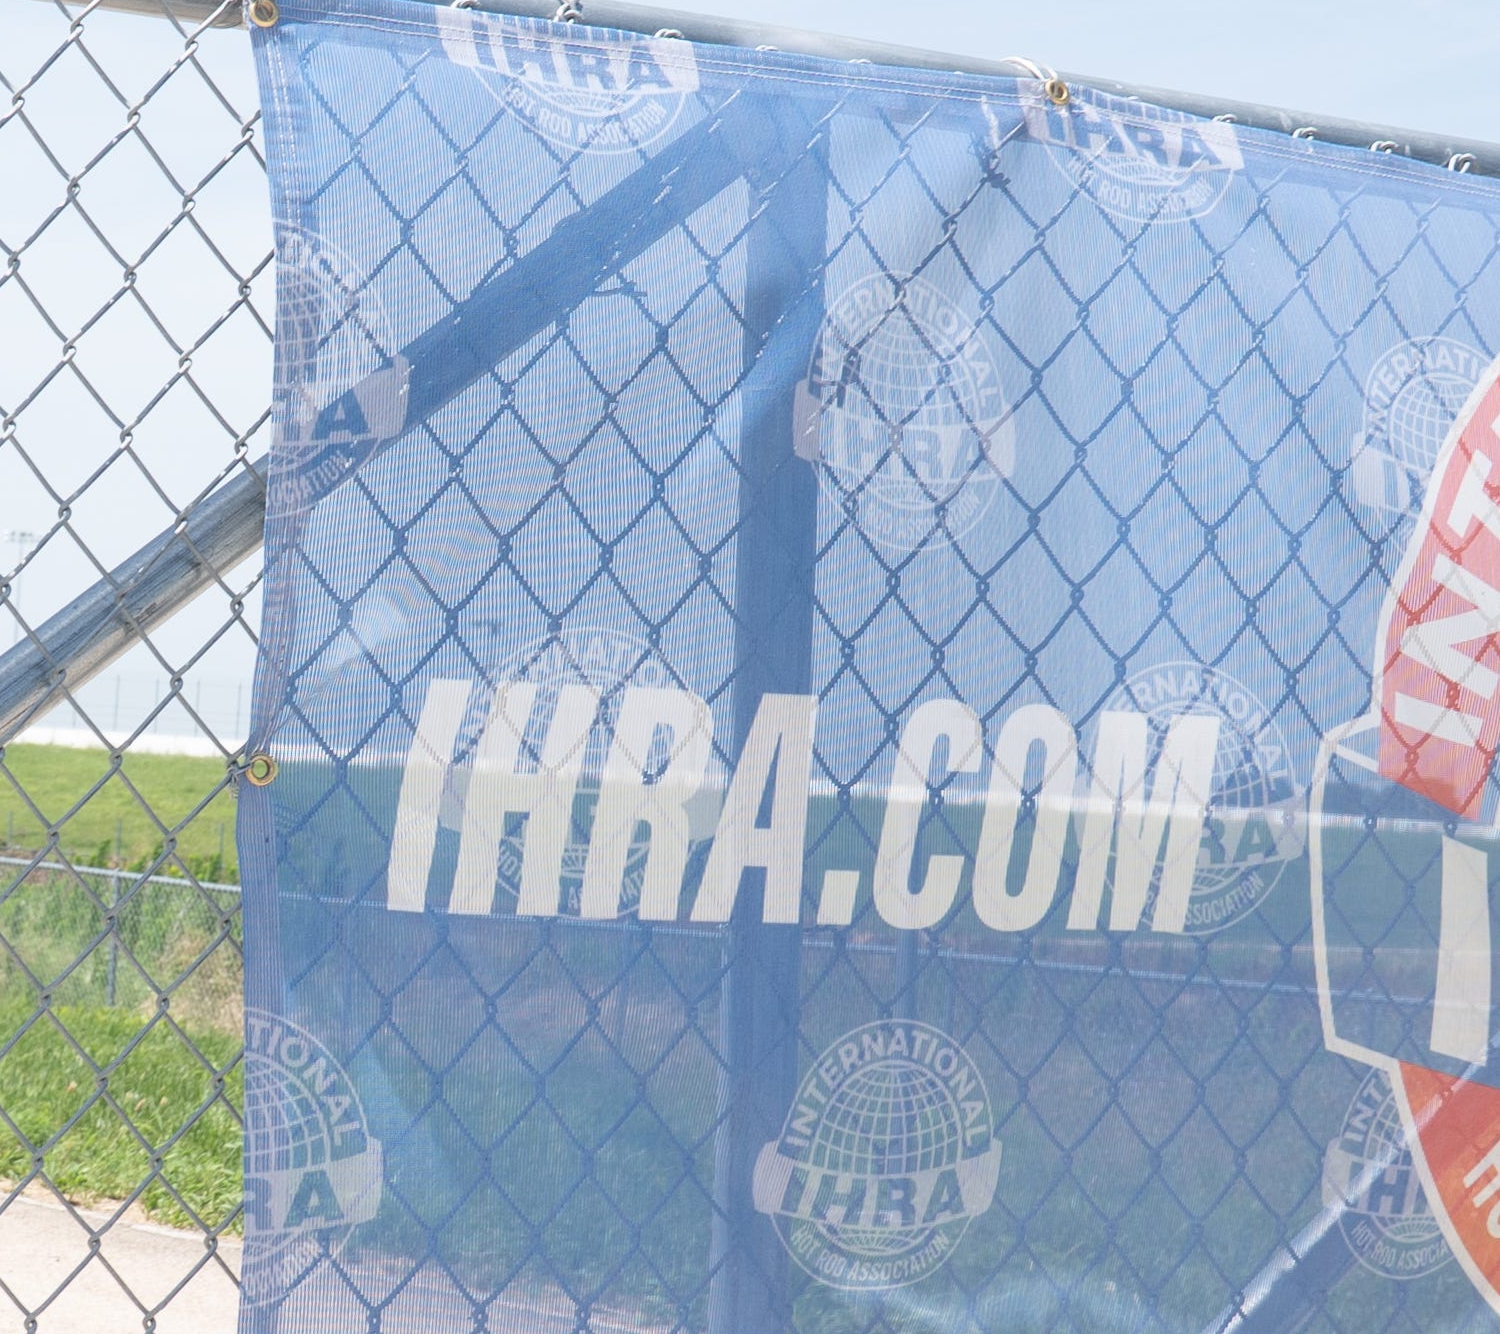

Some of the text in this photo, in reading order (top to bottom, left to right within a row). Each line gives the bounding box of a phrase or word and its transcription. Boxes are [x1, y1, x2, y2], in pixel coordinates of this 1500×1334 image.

[386, 677, 1221, 933] IHRA.COM
[785, 1027, 988, 1148] INTERNATIONAL
[780, 1166, 967, 1228] IHRA
[791, 1224, 950, 1282] HOT ROD ASSOCIATION
[1350, 1219, 1377, 1251] HOT
